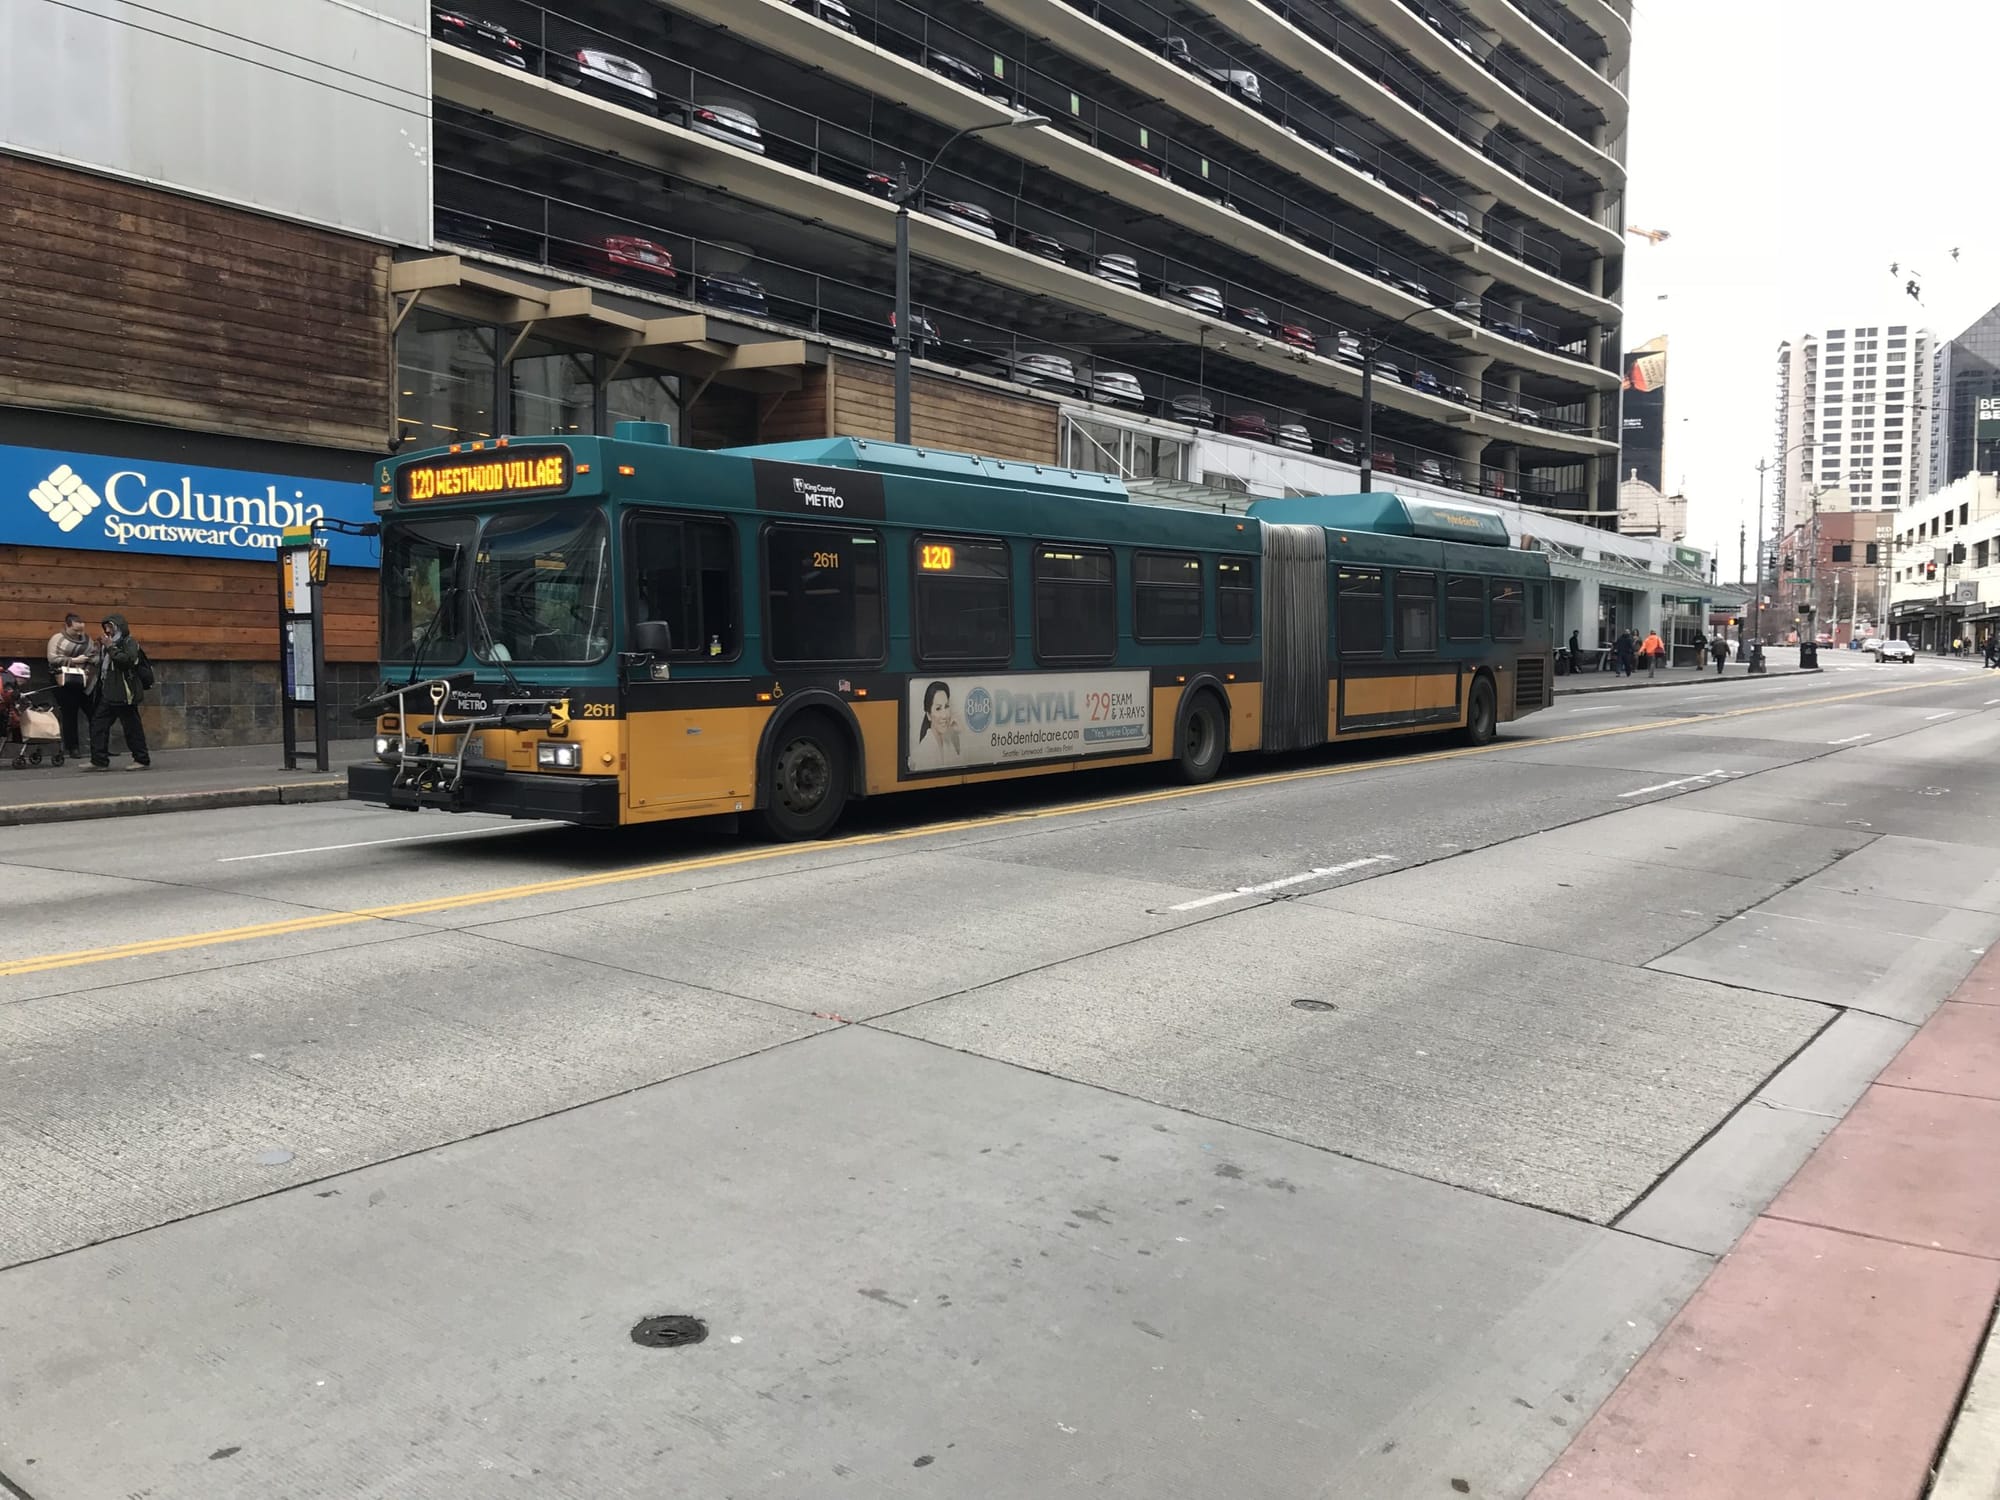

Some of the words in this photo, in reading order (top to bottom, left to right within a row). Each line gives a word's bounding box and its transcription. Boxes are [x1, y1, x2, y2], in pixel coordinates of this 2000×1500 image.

[411, 469, 434, 499] 120
[436, 463, 503, 495] WESTWOOD
[505, 457, 563, 489] VILLAGE
[817, 484, 836, 495] County
[104, 471, 328, 531] Columbia
[805, 493, 844, 509] METRO
[813, 552, 839, 569] 2611
[922, 545, 952, 570] 120
[458, 699, 487, 711] METRO
[967, 697, 991, 716] 8to8
[1111, 693, 1133, 706] EXAM
[583, 703, 616, 718] 2611
[1119, 706, 1145, 719] X-RAYS
[991, 729, 1080, 747] 8to8dentalcare.com
